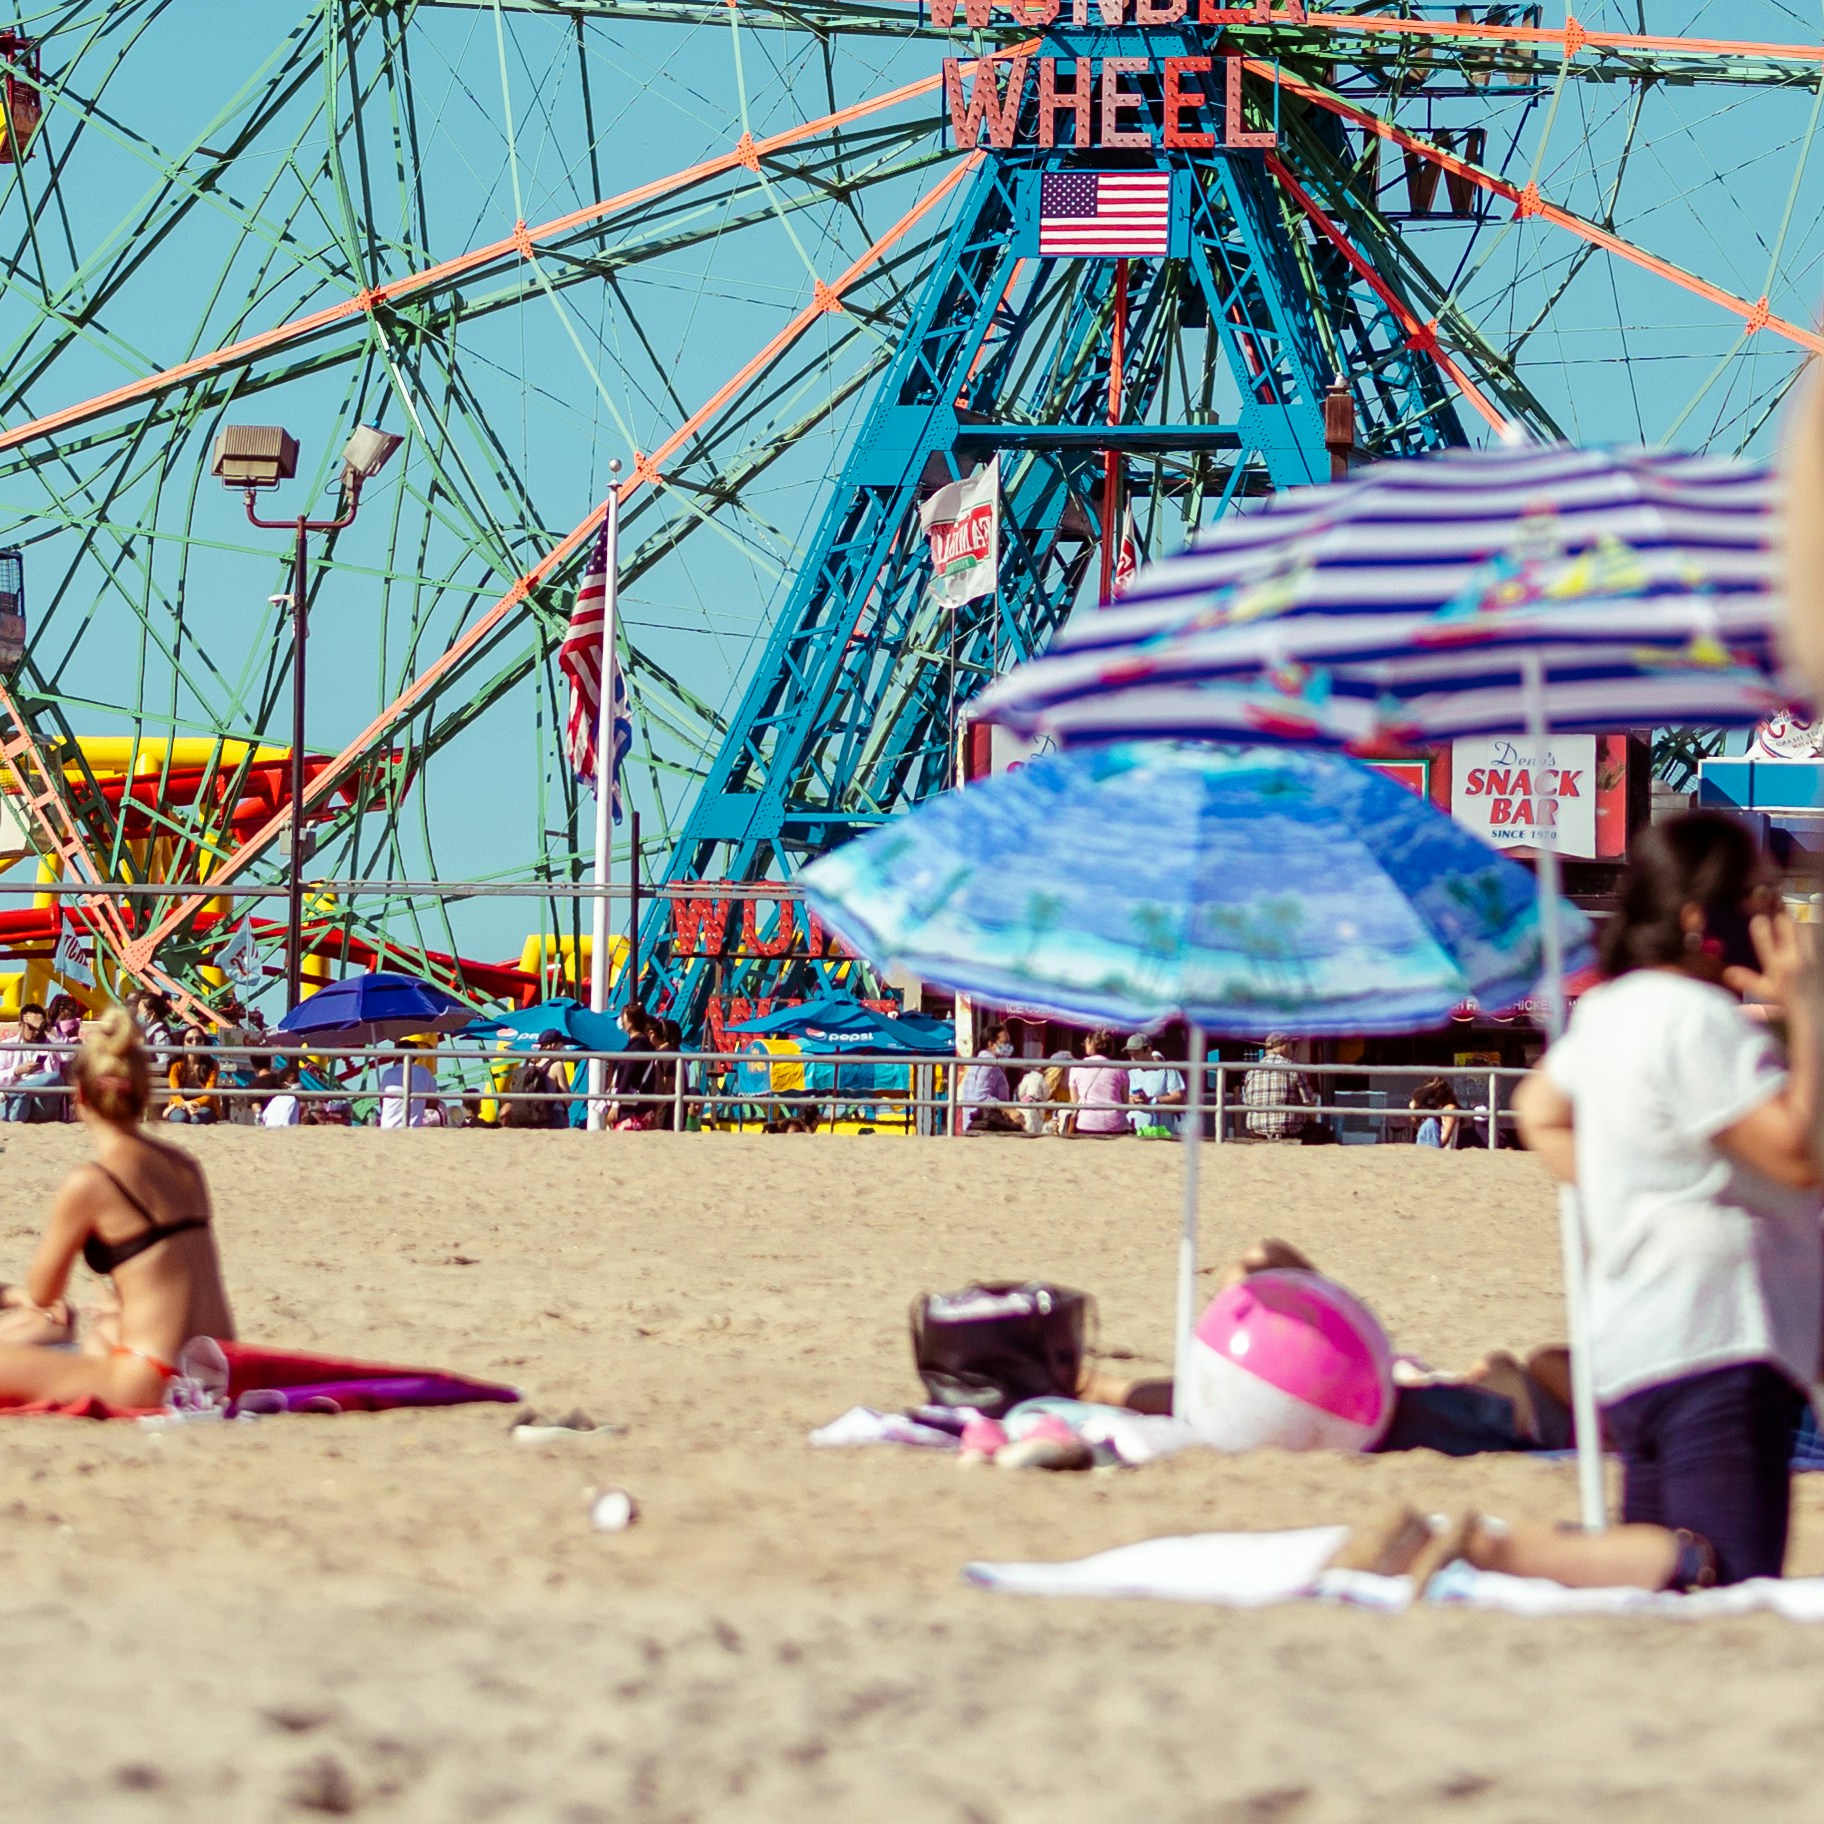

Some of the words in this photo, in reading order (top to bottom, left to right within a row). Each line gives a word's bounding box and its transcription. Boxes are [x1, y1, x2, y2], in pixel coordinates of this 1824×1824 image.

[942, 56, 1277, 149] WHEEL
[1464, 768, 1584, 797] SNACK
[1489, 798, 1559, 826] BAR
[1491, 829, 1526, 839] SINCE
[1005, 1003, 1024, 1014] ICE
[1505, 999, 1553, 1012] HICKE
[828, 1031, 874, 1043] pepsi
